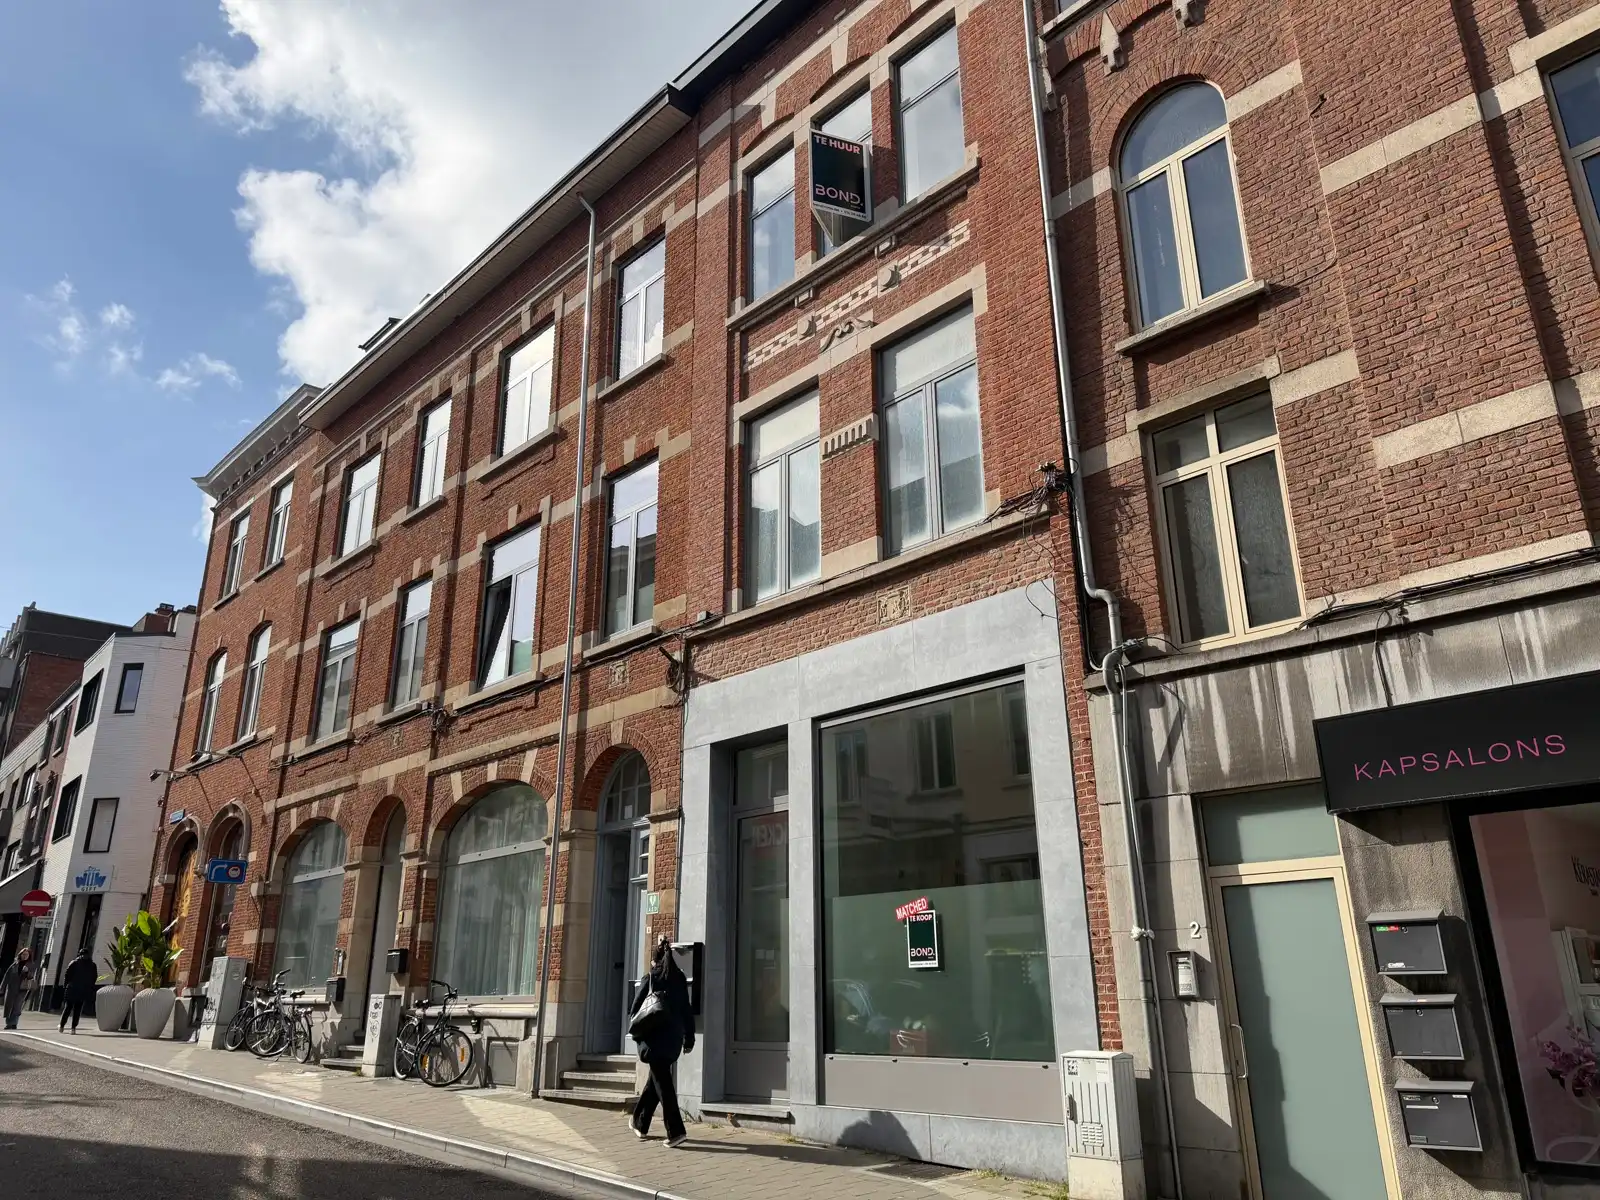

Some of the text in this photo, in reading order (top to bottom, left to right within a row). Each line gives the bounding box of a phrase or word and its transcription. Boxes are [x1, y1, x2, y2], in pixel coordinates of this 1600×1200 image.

[814, 135, 860, 154] TE HUUR
[1354, 735, 1566, 781] KAPSALONS
[917, 914, 933, 922] KOOP
[1190, 921, 1201, 938] 2
